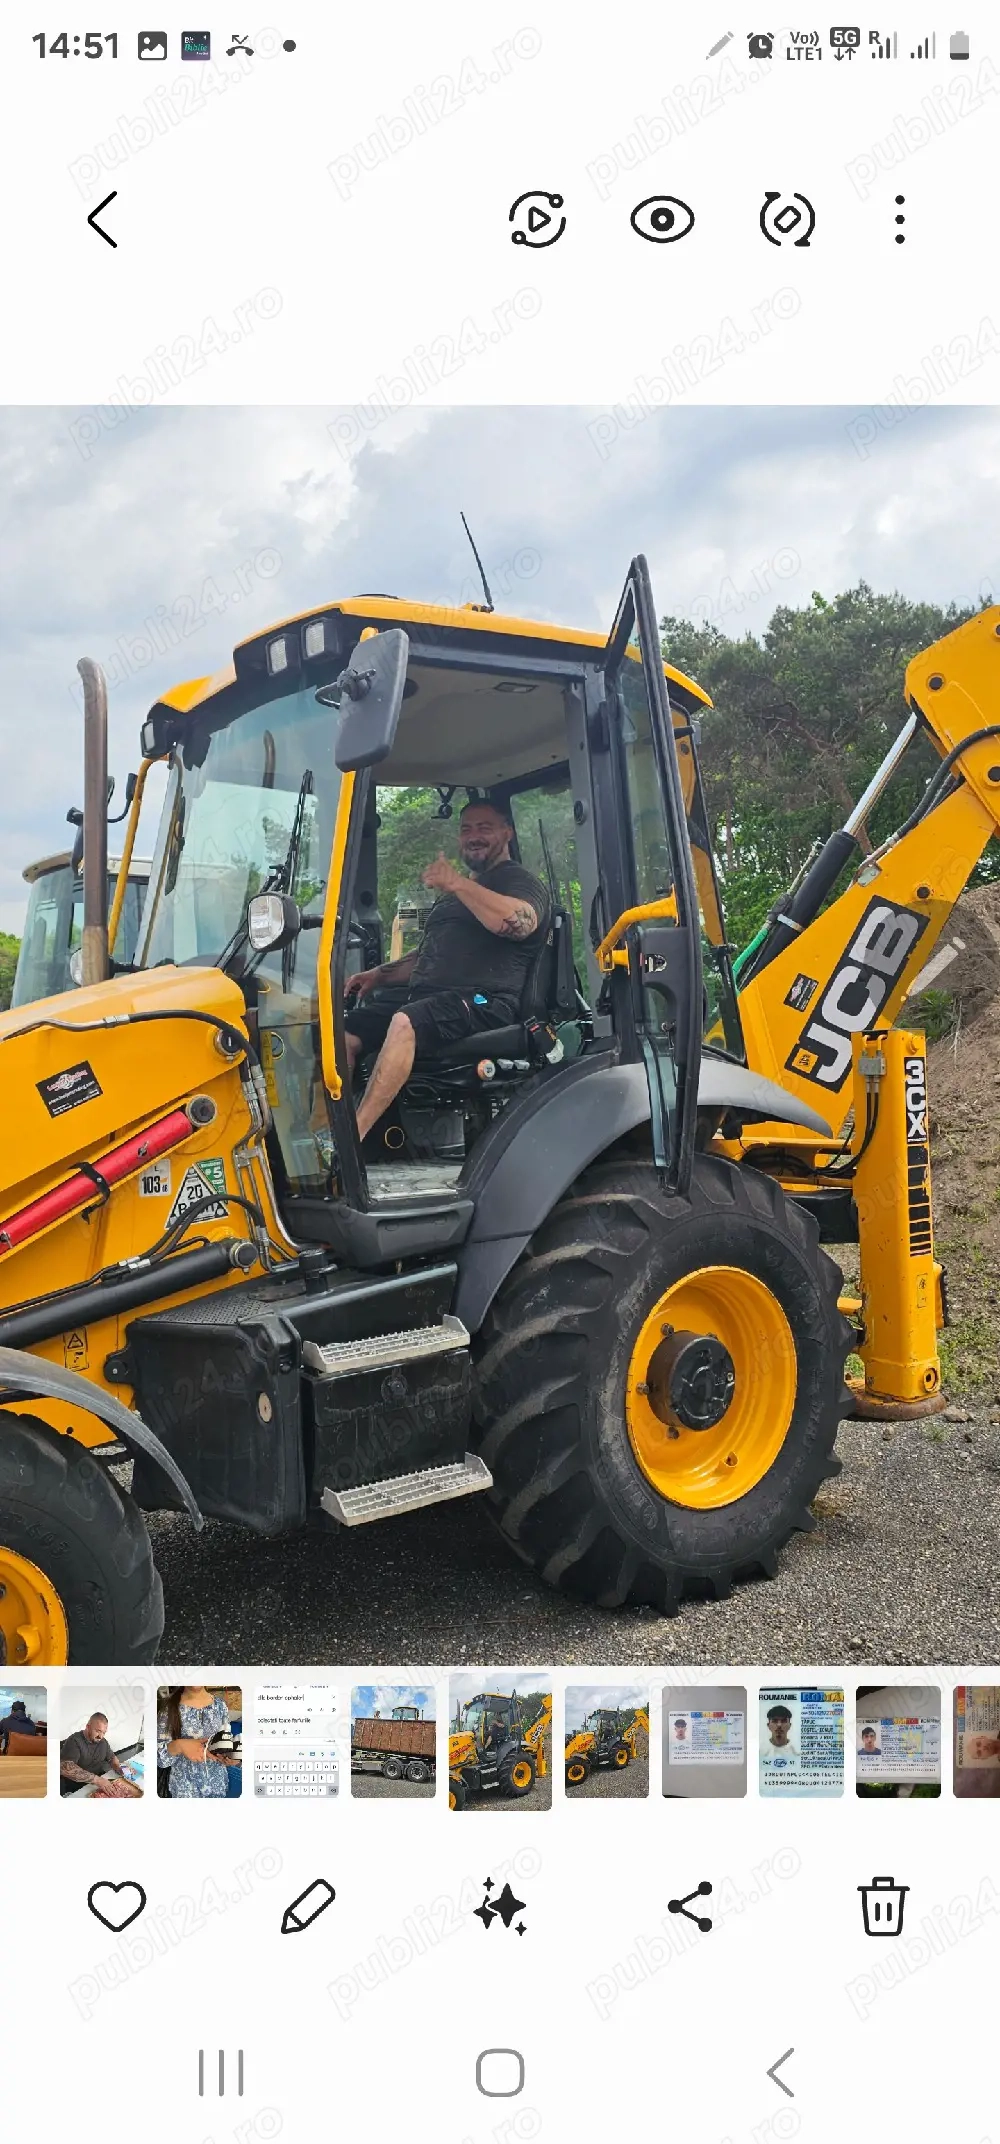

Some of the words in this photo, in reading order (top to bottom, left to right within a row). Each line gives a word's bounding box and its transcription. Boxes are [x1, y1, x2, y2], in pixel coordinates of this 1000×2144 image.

[32, 32, 118, 60] 14:51
[833, 30, 857, 45] 5G
[869, 31, 880, 45] R
[786, 47, 823, 61] LTE1
[807, 906, 919, 1083] JCB
[906, 1060, 926, 1138] 3CX
[213, 1165, 223, 1179] 5
[141, 1175, 161, 1194] 103
[186, 1184, 204, 1201] 20
